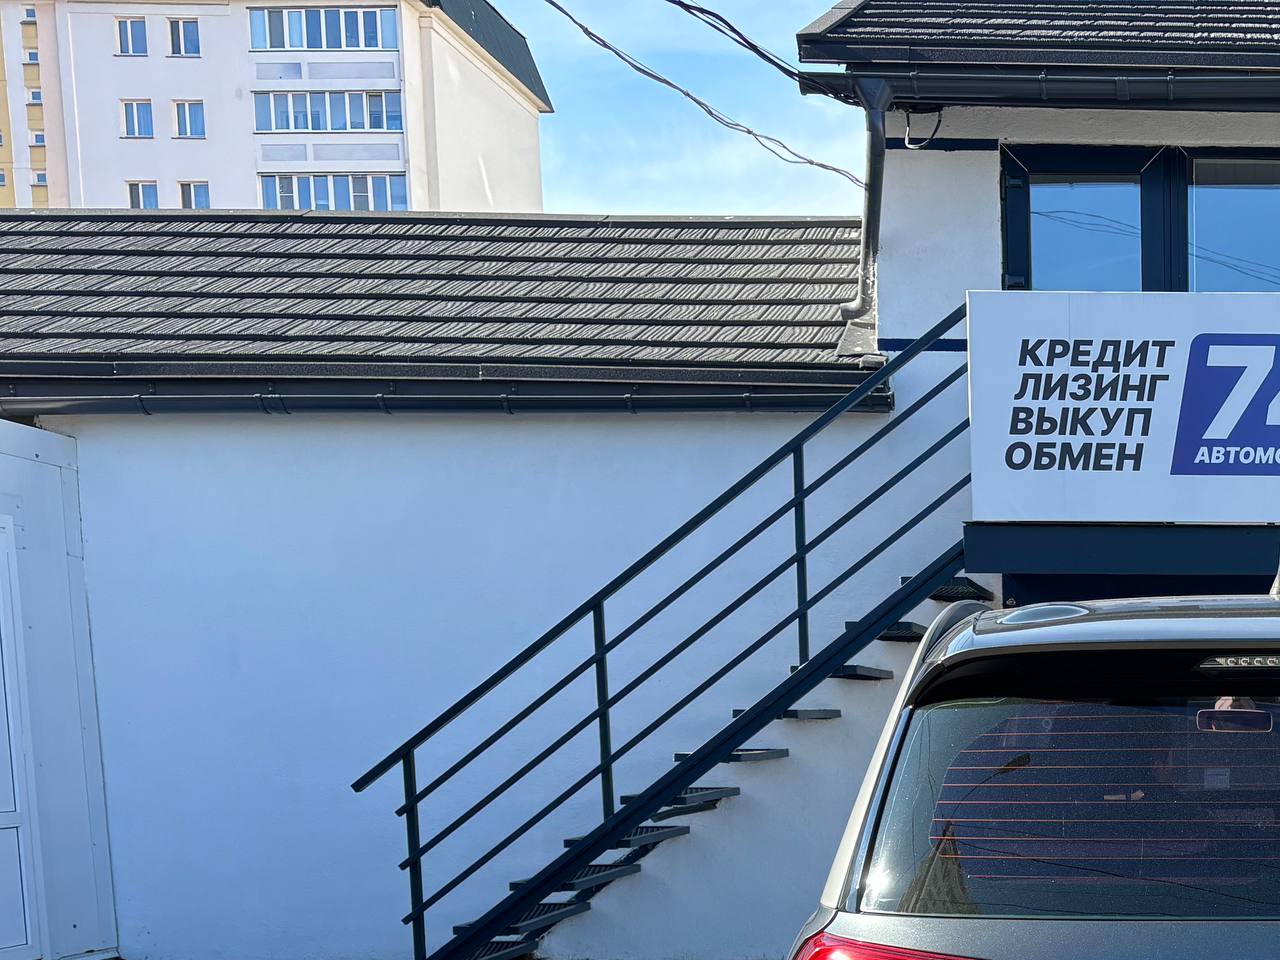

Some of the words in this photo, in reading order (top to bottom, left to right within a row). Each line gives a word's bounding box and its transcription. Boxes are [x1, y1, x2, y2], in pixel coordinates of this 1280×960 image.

[1018, 338, 1176, 373] КРЕДИТ
[1013, 373, 1170, 402] ЛИЗИНГ
[1008, 406, 1153, 437] ВЫКУП
[1004, 441, 1145, 472] ОБМЕН
